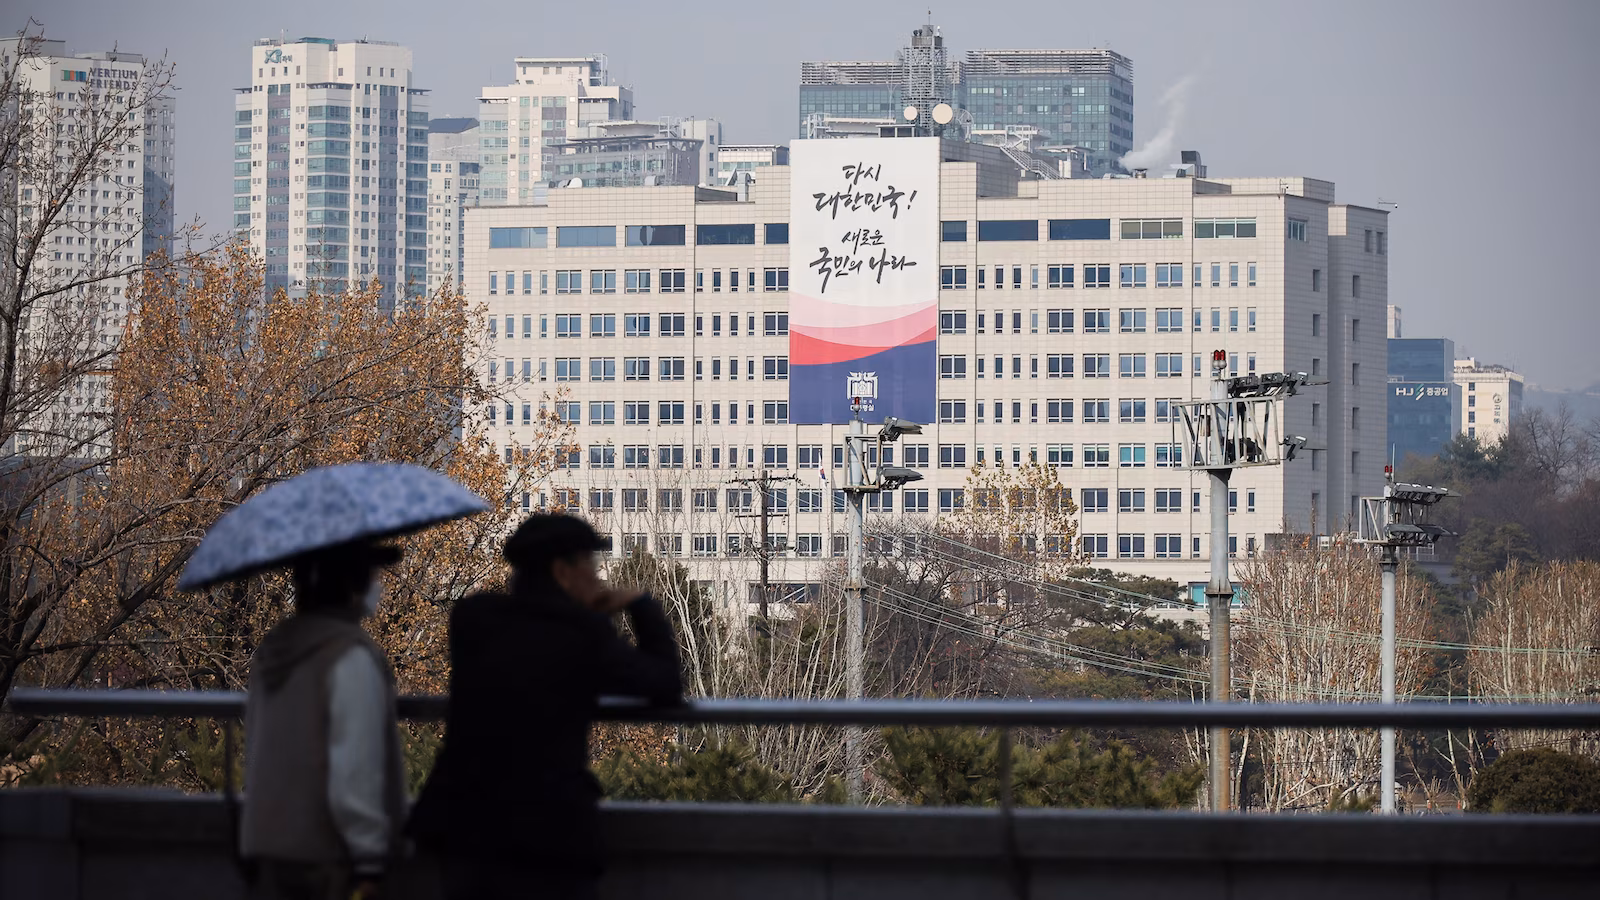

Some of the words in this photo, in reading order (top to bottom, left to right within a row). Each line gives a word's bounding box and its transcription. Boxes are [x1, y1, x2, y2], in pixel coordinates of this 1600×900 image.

[90, 67, 138, 80] VERTIUM
[90, 79, 137, 91] FRIENDS
[842, 161, 881, 185] 다시
[812, 183, 918, 220] 대한민국!
[841, 228, 885, 255] 새로운
[809, 247, 863, 294] 국민의
[869, 248, 917, 284] 나라
[1395, 387, 1414, 396] HJ
[1426, 387, 1449, 397] 중공업
